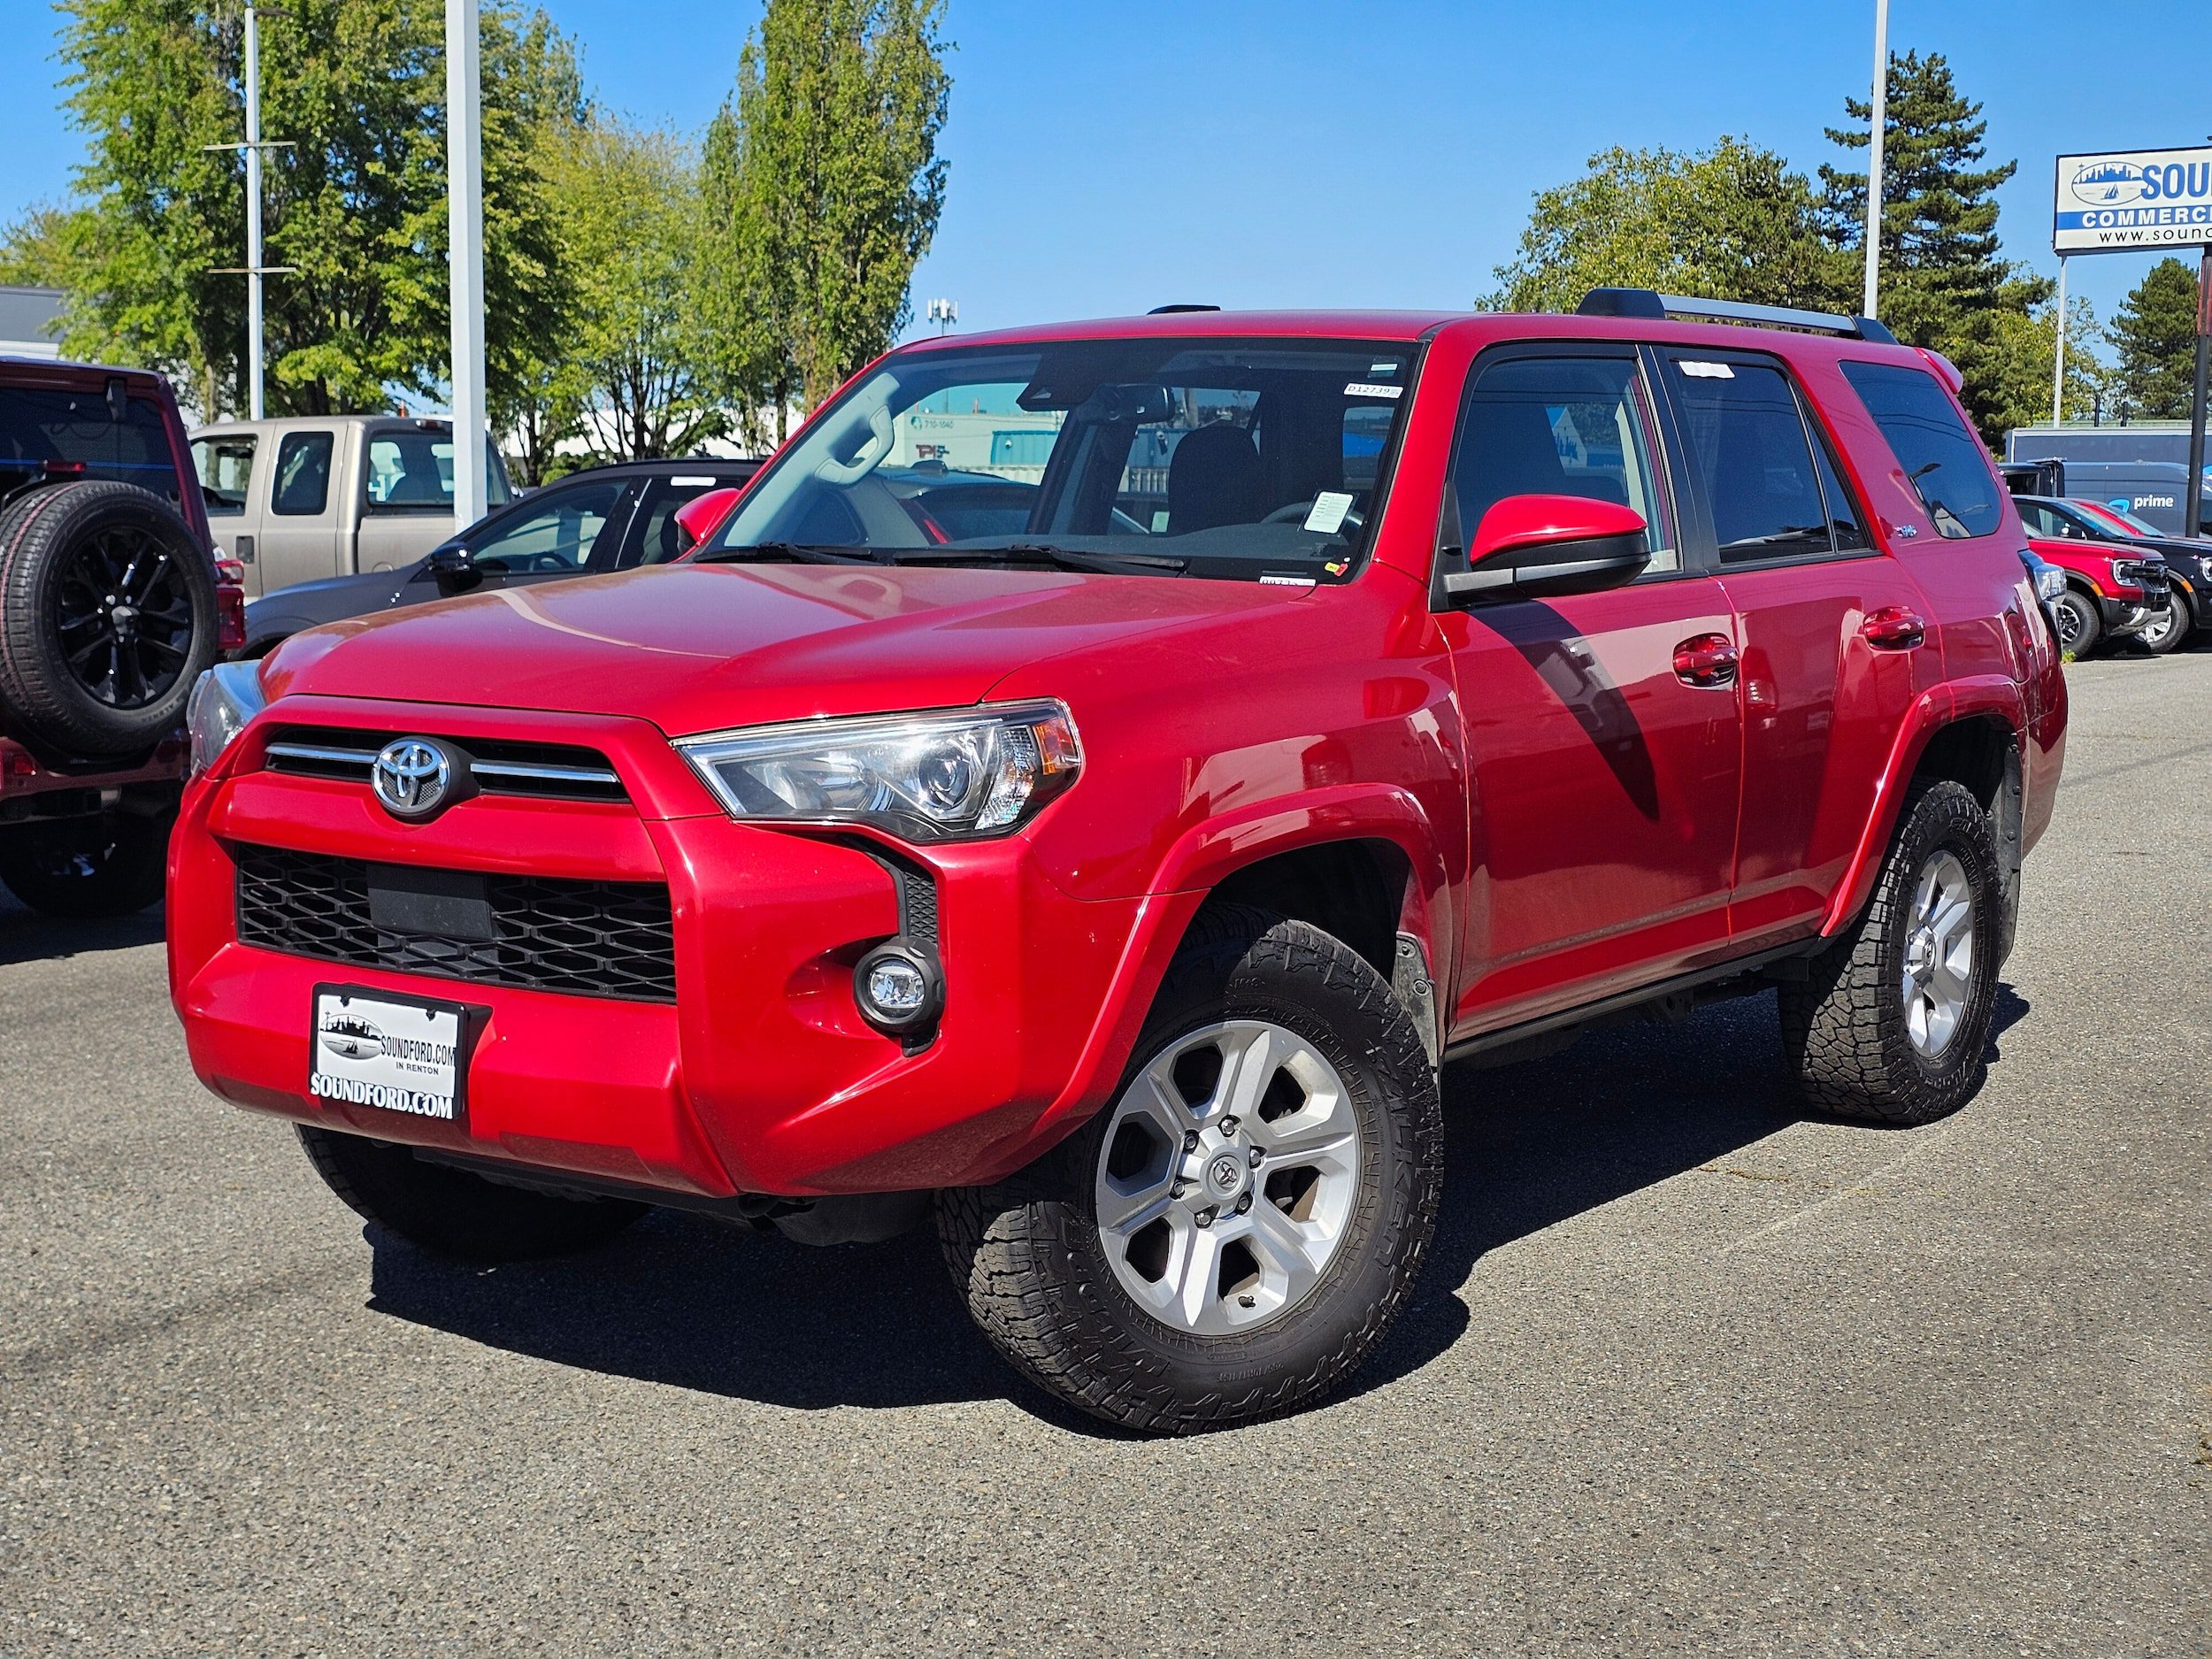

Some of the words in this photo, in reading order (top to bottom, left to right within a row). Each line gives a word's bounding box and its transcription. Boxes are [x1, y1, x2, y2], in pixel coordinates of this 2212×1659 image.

[2140, 162, 2212, 200] SOU
[2133, 494, 2174, 511] prime
[380, 1034, 455, 1067] SOUNDFORD.COM
[396, 1061, 404, 1071] IN
[406, 1062, 439, 1076] RENTON
[311, 1071, 453, 1119] SOUNDFORD.COM
